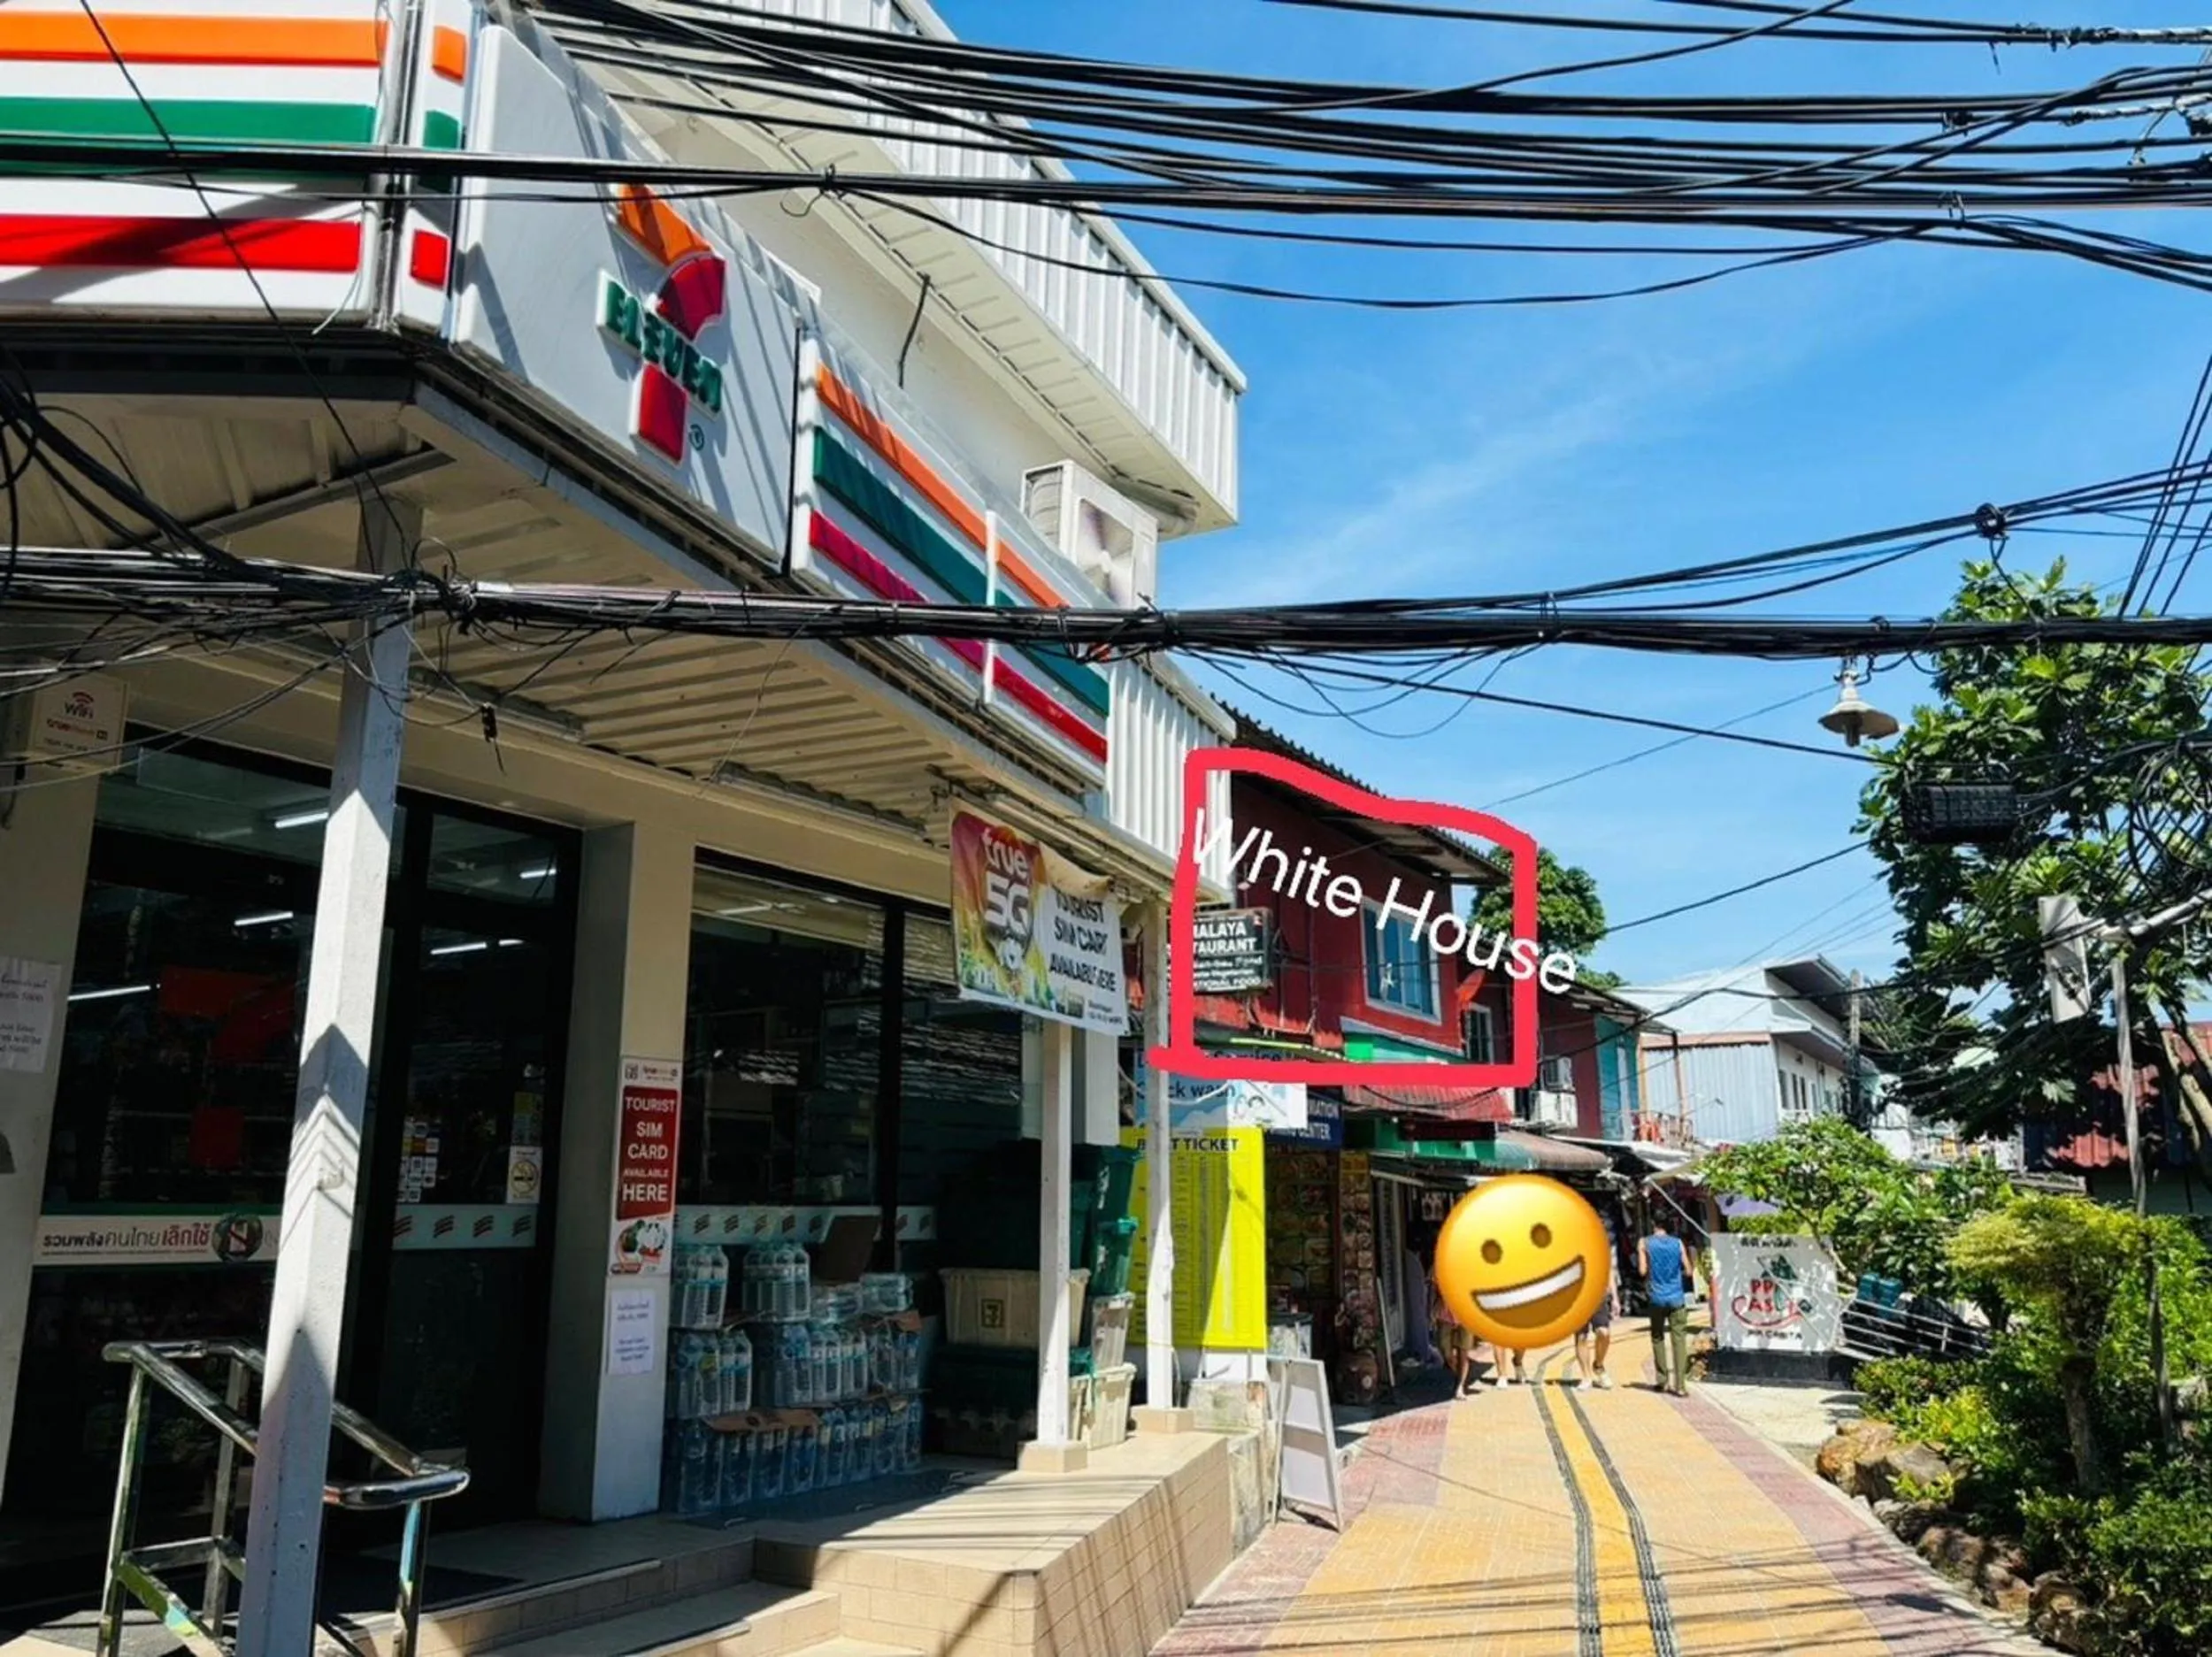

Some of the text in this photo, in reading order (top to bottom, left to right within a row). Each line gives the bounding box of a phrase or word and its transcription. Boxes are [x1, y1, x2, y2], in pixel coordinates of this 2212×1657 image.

[980, 826, 1029, 878] true
[984, 870, 1031, 935] 5G
[625, 1097, 676, 1113] TOURIST
[636, 1121, 664, 1138] SIM
[627, 1145, 669, 1161] CARD
[1181, 1138, 1240, 1152] TICKET
[623, 1168, 670, 1178] AVAILABLE
[622, 1184, 669, 1202] HERE
